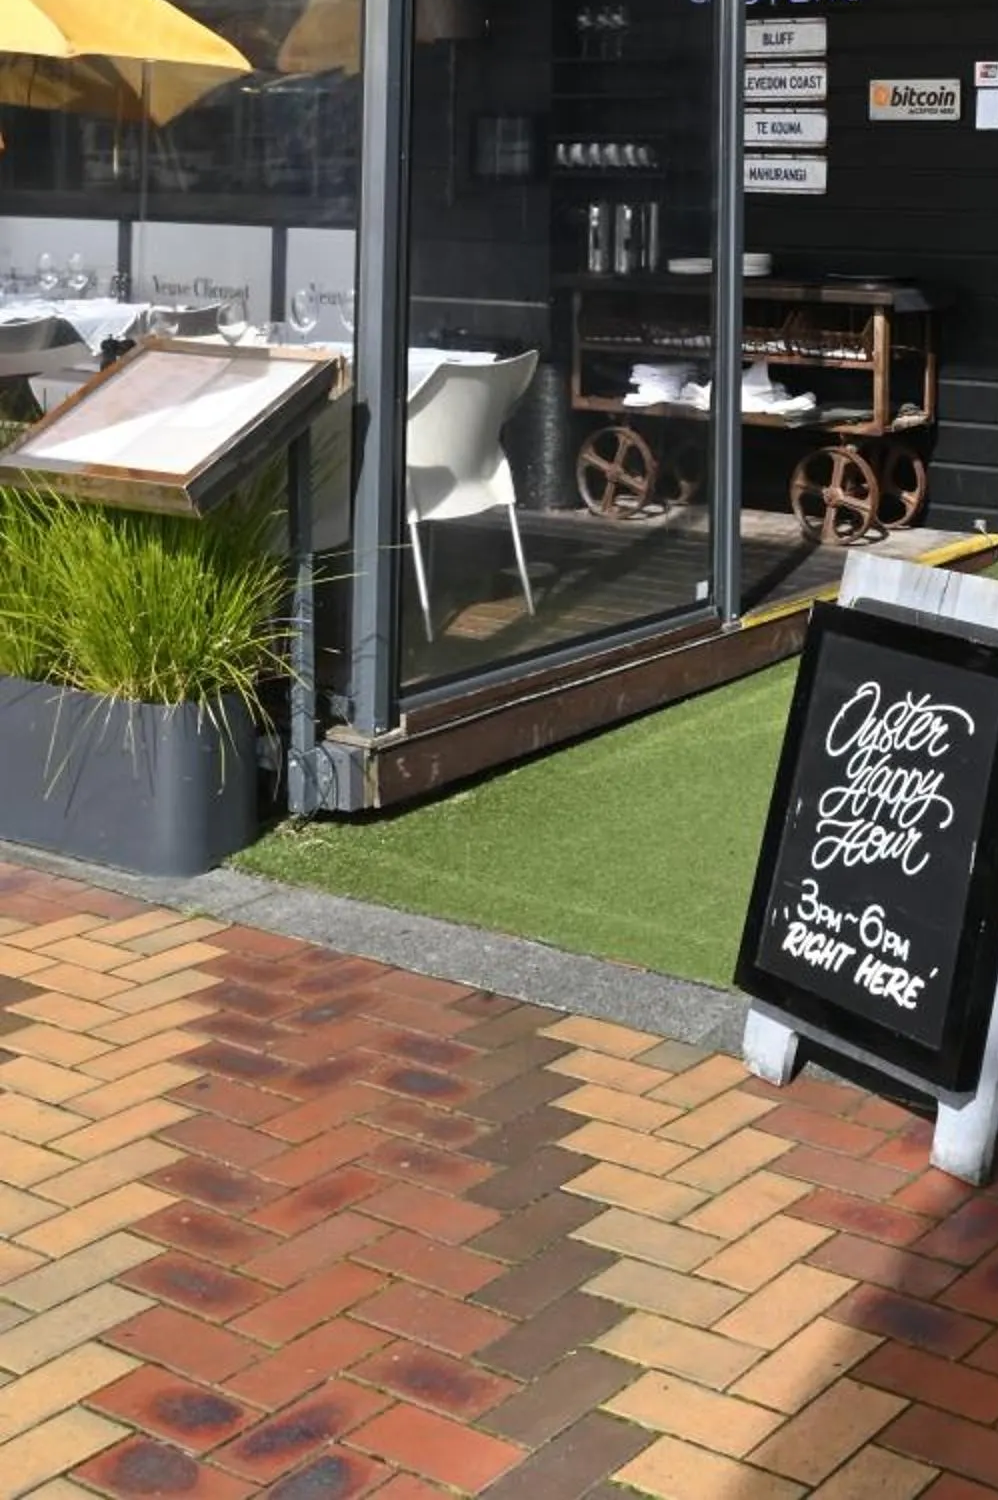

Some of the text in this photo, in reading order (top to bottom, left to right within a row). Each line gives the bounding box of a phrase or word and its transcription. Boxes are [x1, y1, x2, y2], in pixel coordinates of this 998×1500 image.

[762, 31, 795, 46] BLUFF
[789, 75, 823, 89] COAST
[889, 86, 955, 106] bitcoin
[756, 121, 768, 134] TE
[749, 167, 807, 181] MAHURANGI
[826, 681, 975, 779] Oyster
[818, 753, 954, 829] Happy
[811, 818, 930, 876] Hour
